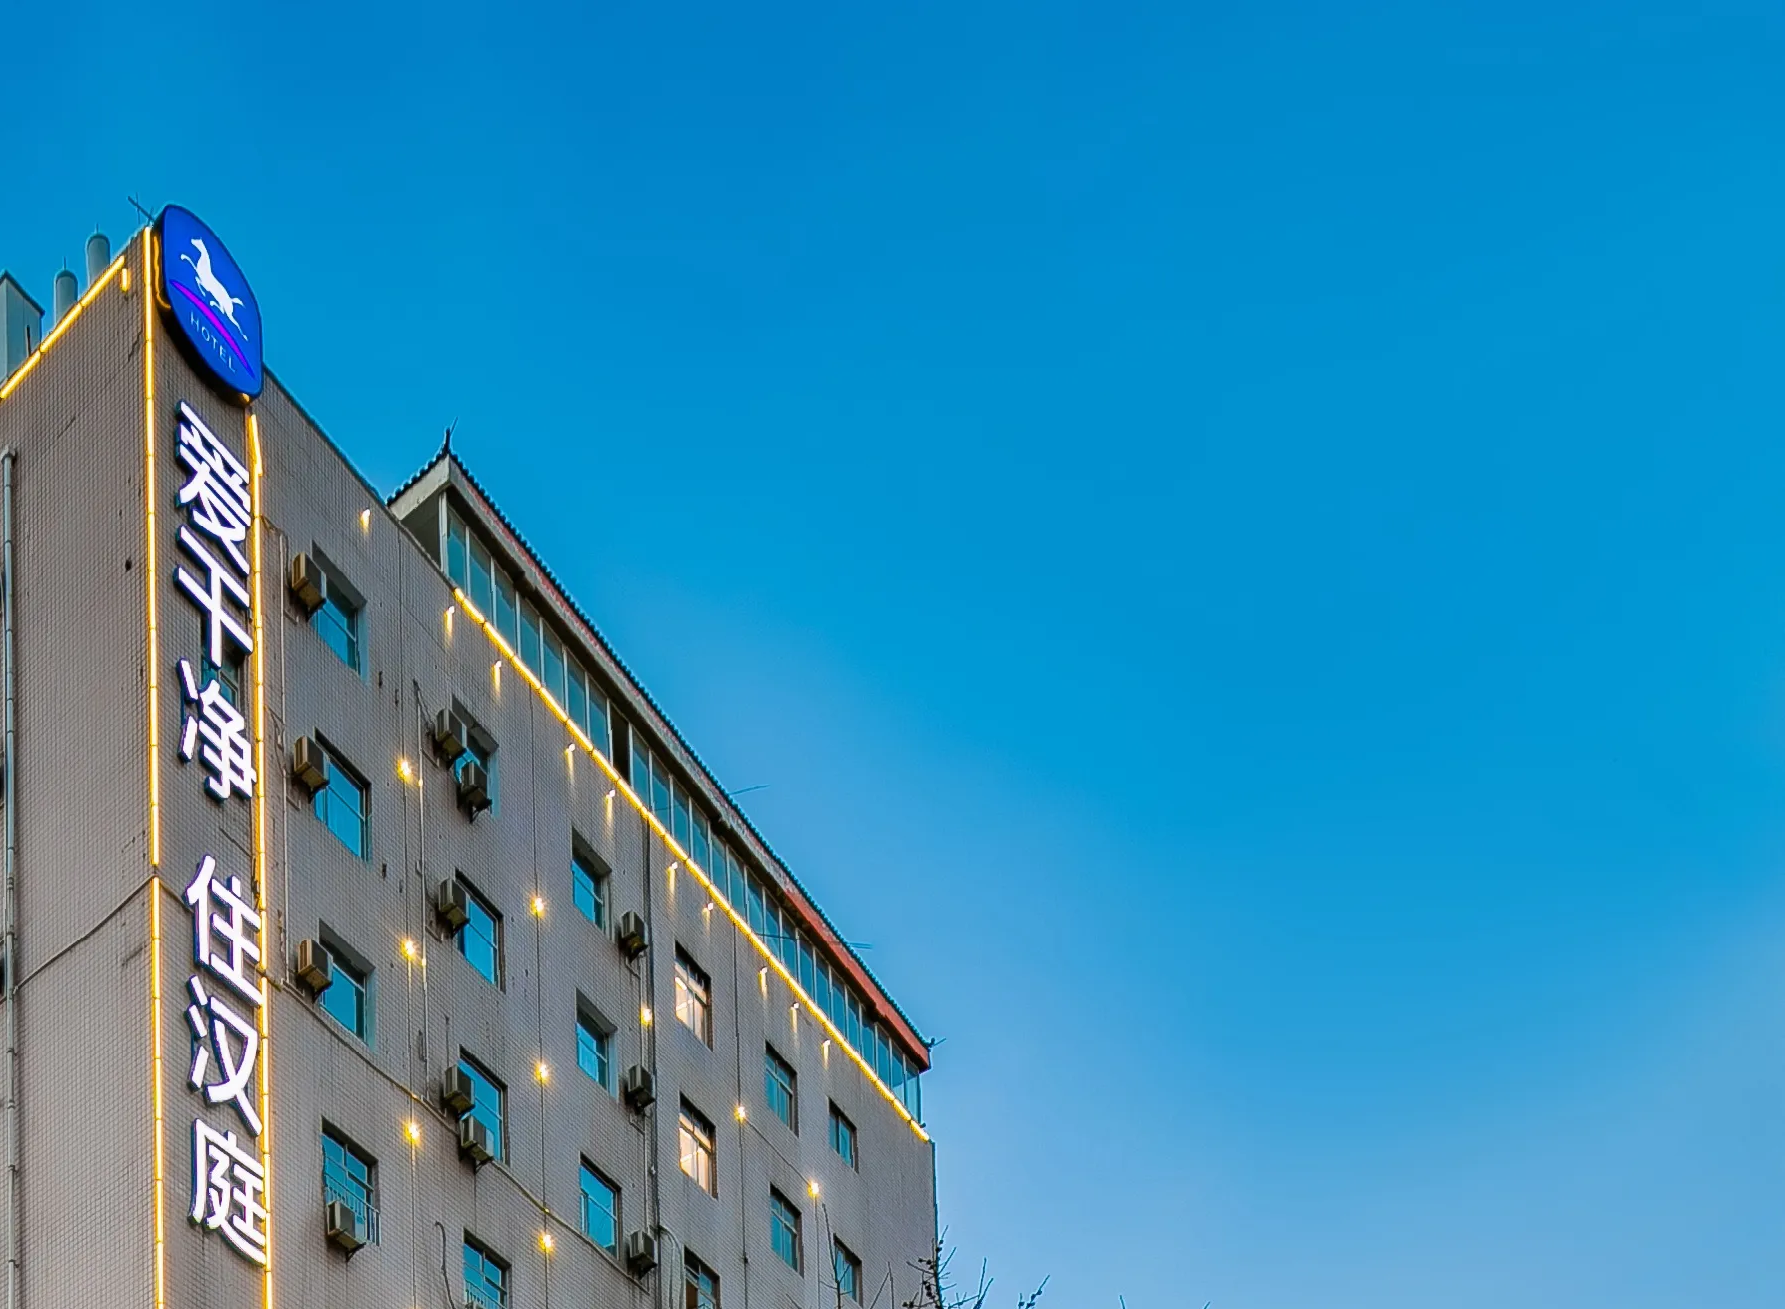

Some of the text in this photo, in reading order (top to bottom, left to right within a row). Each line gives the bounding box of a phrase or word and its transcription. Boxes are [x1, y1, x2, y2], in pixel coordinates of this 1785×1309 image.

[190, 311, 236, 374] HOTEL
[175, 400, 267, 1266] 爱干净 住汉庭
